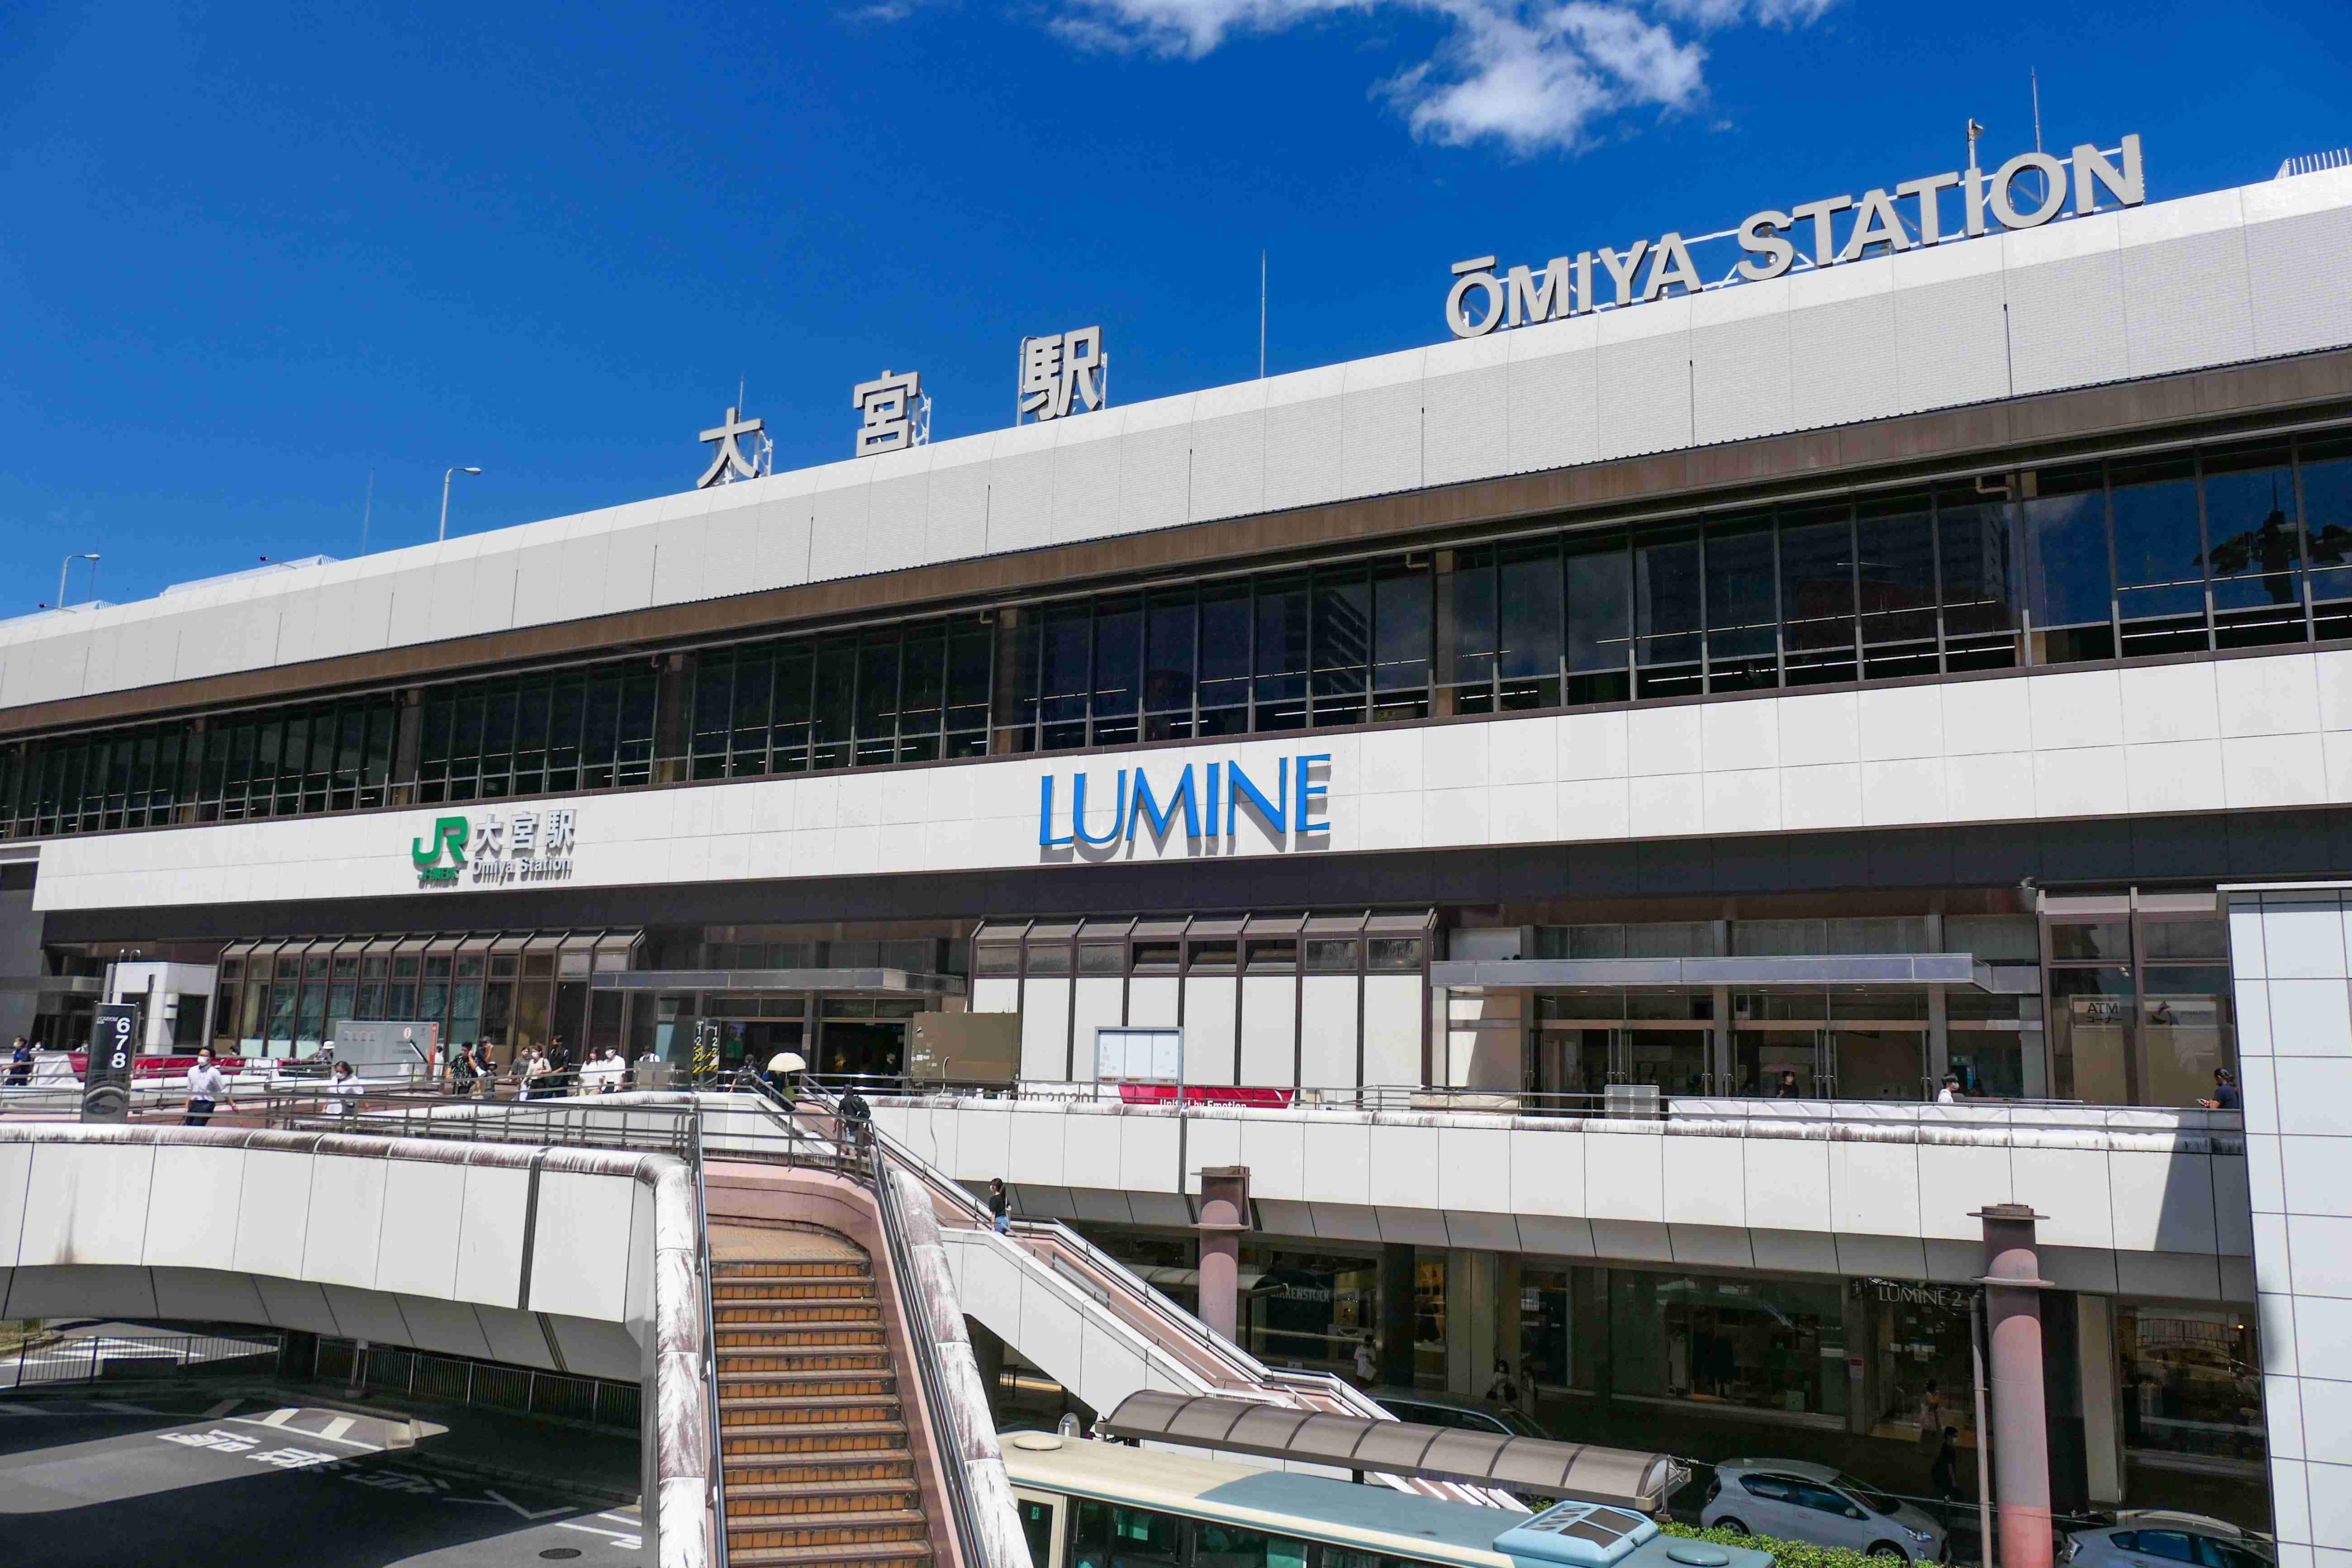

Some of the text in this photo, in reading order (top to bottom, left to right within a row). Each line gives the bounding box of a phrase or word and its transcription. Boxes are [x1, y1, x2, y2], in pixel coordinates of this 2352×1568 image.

[1445, 133, 2144, 338] ŌMIYA STATION
[697, 325, 1102, 489] 大宮駅
[1039, 753, 1331, 846] LUMINE
[412, 816, 469, 864] JR
[474, 808, 577, 851] 大宮駅
[521, 856, 571, 873] Station
[2087, 1002, 2119, 1014] ATM
[111, 1017, 131, 1069] 6 7 8
[712, 1037, 718, 1047] 2
[1160, 1098, 1191, 1107] Unitd
[1207, 1100, 1247, 1108] Emotion
[1879, 1286, 1962, 1307] LUMINE 2
